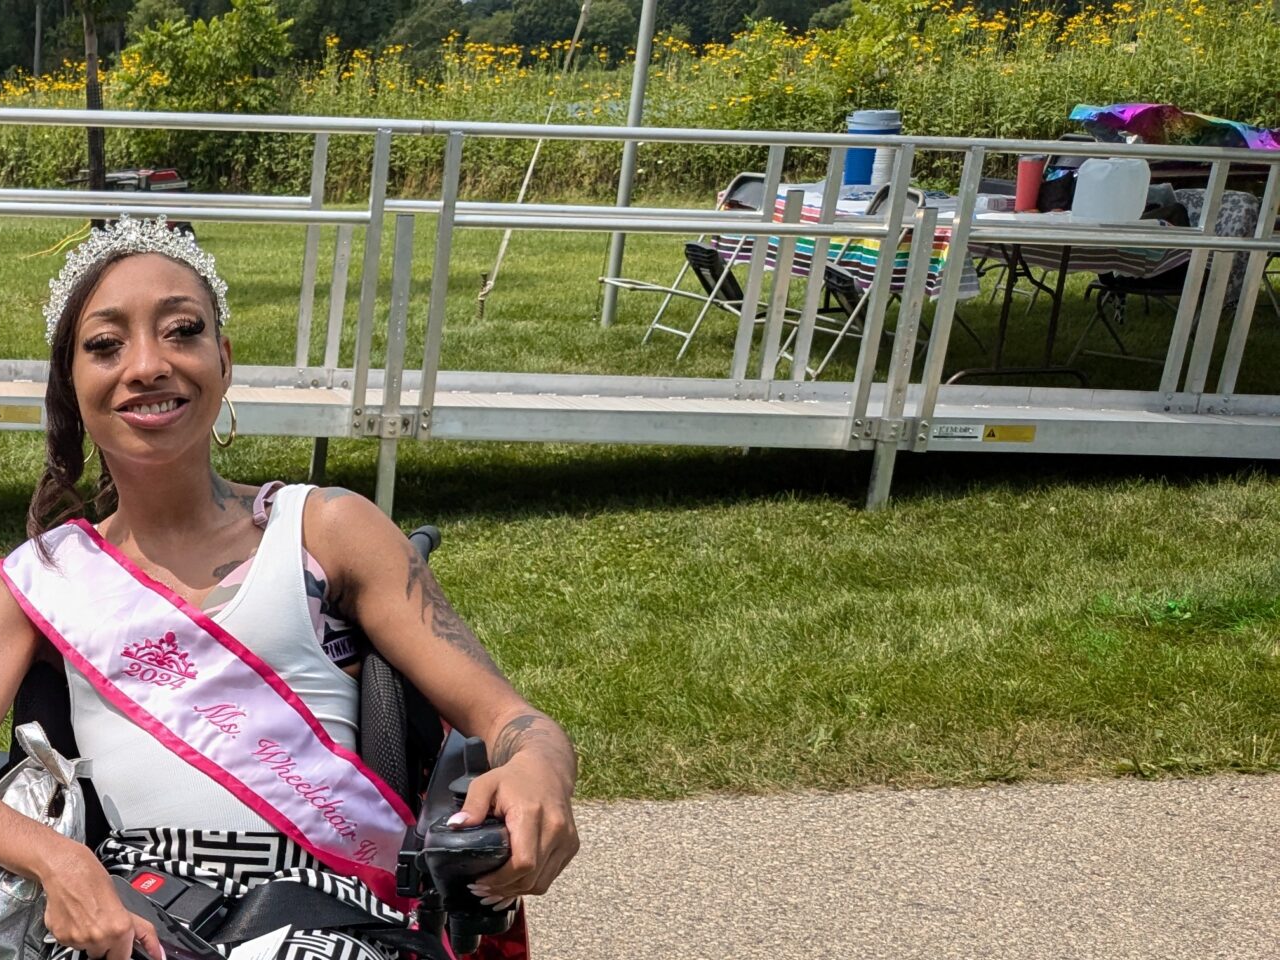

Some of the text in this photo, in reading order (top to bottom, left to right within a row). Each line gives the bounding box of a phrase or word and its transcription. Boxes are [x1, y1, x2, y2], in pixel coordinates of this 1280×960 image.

[121, 662, 186, 690] 2024
[194, 704, 247, 739] Ms.
[251, 738, 358, 842] Wheelchair
